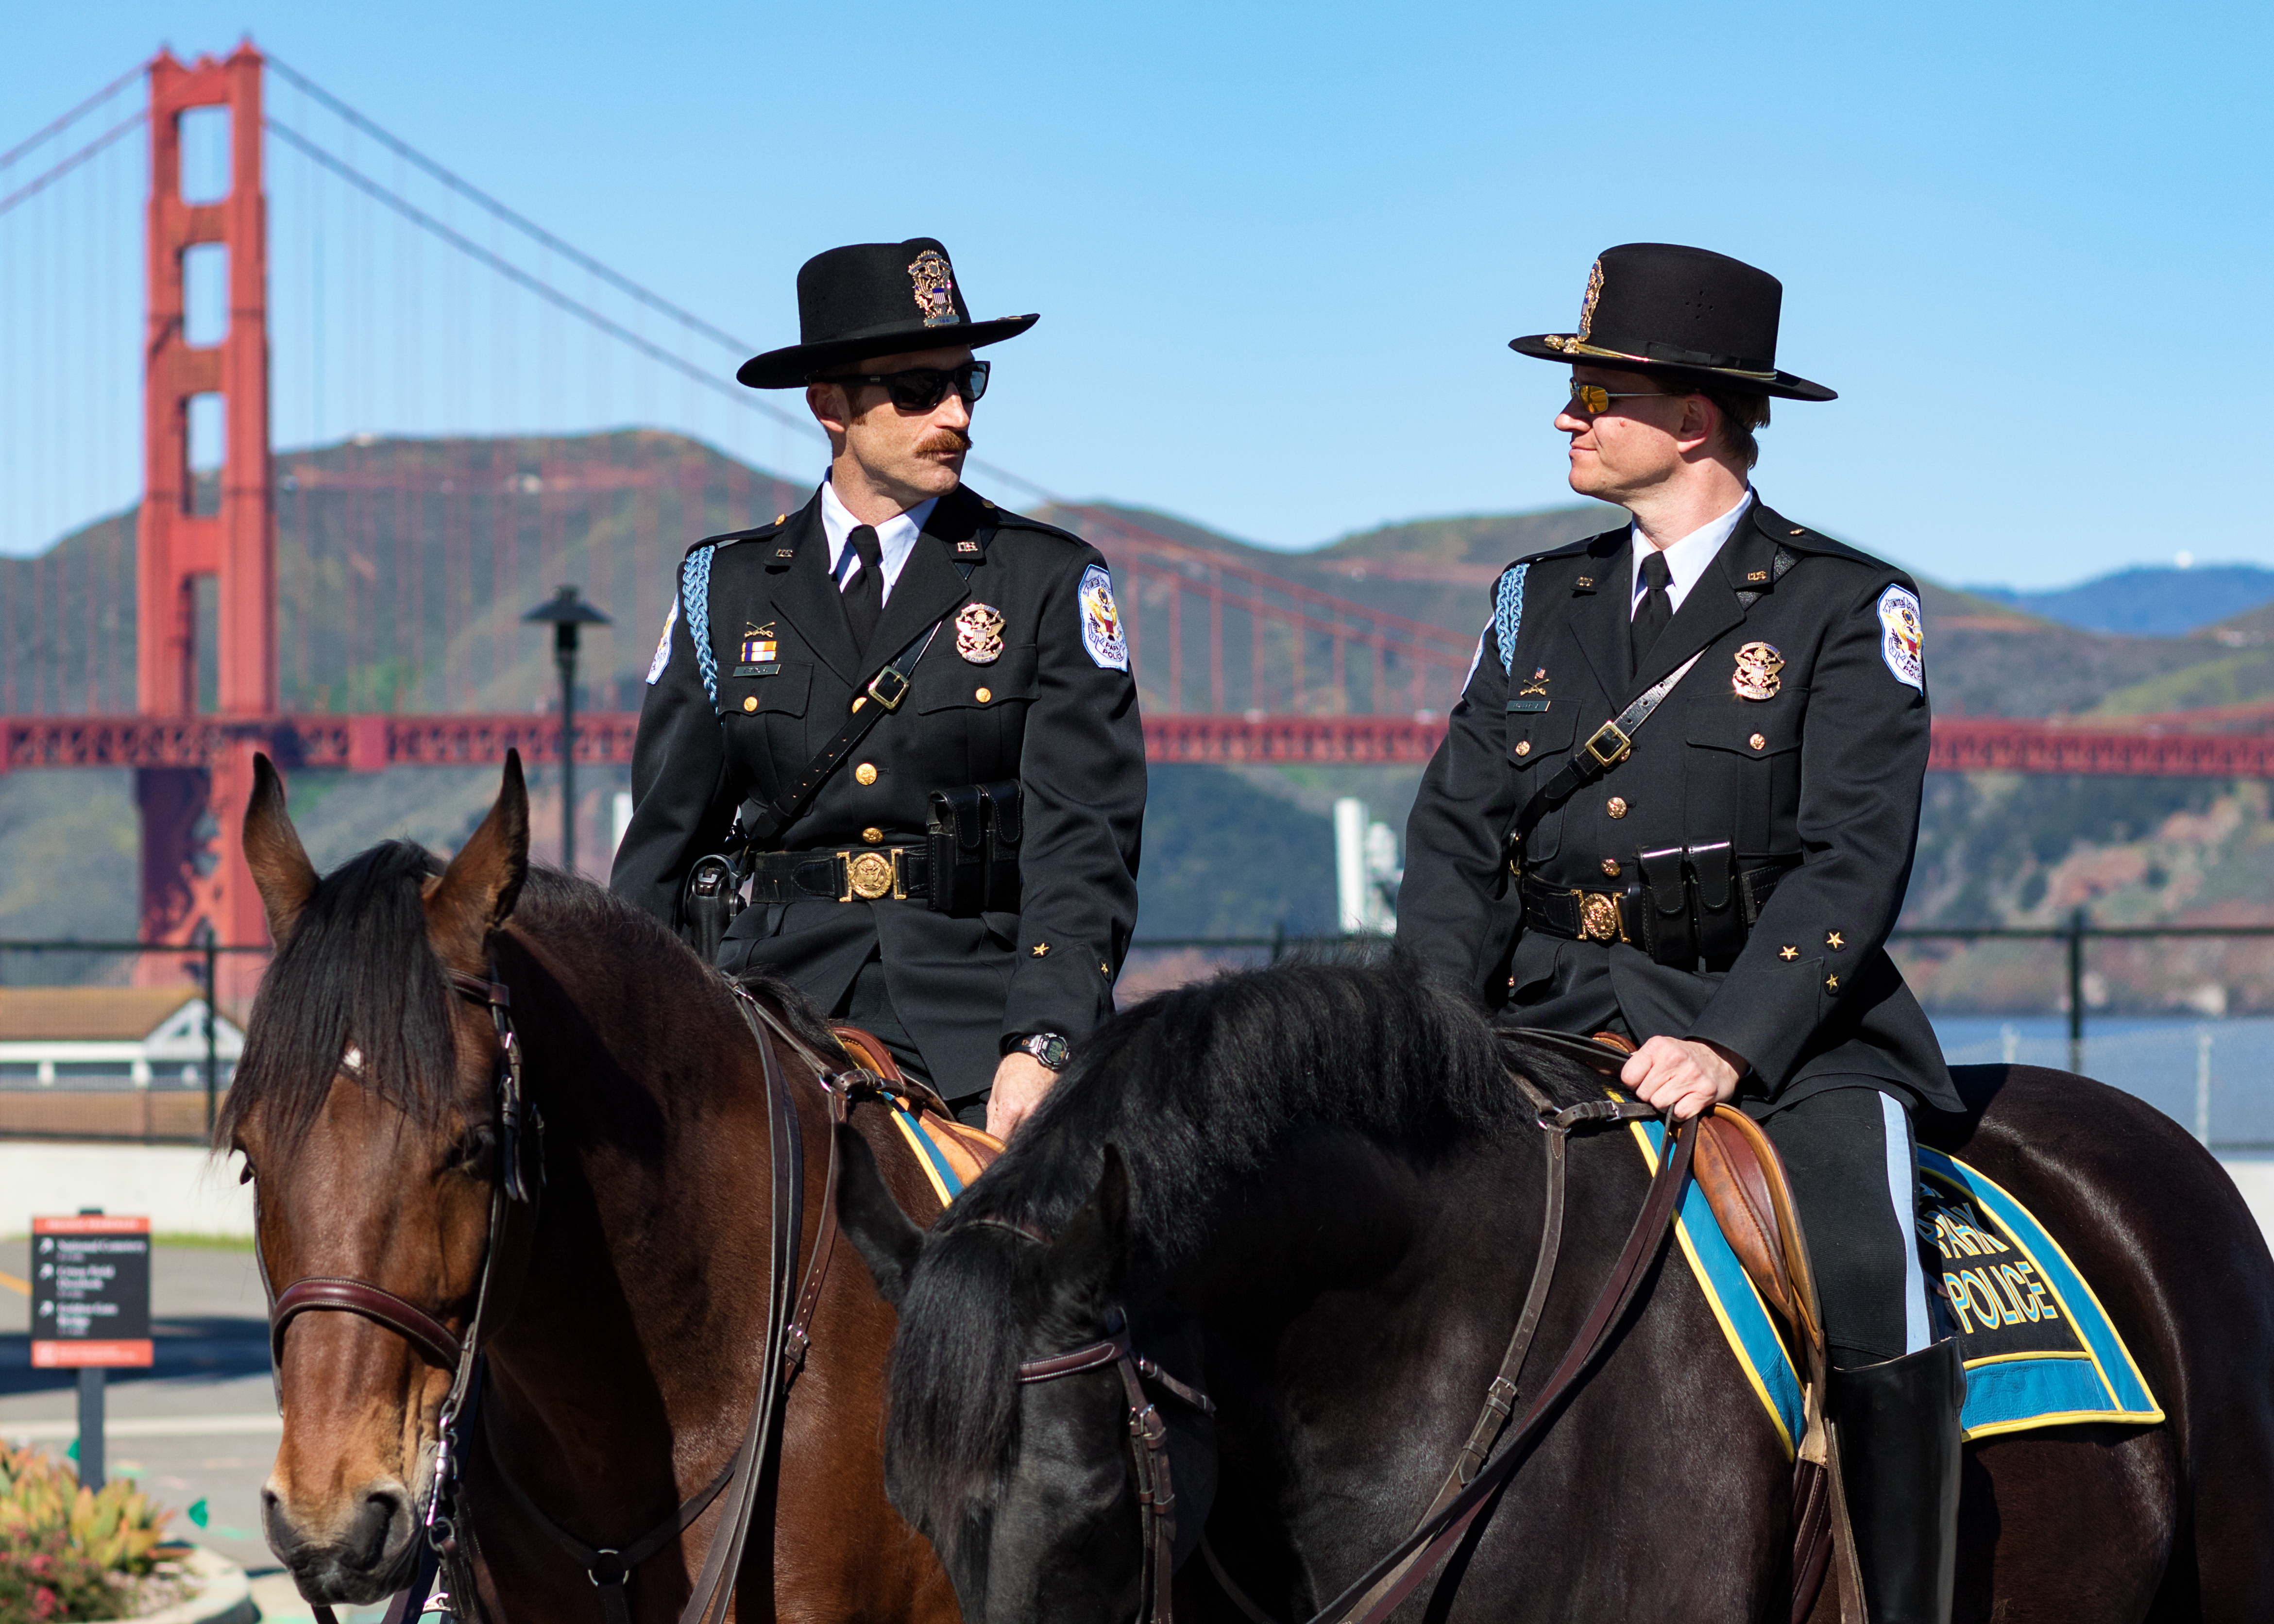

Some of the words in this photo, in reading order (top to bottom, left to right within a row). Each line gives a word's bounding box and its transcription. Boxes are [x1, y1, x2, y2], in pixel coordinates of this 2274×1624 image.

[983, 605, 997, 614] STATES
[1105, 642, 1119, 651] PARK
[966, 655, 994, 663] POLICE
[1103, 649, 1123, 660] POLICE
[1916, 1202, 2010, 1259] PARK
[1942, 1260, 2059, 1334] POLICE
